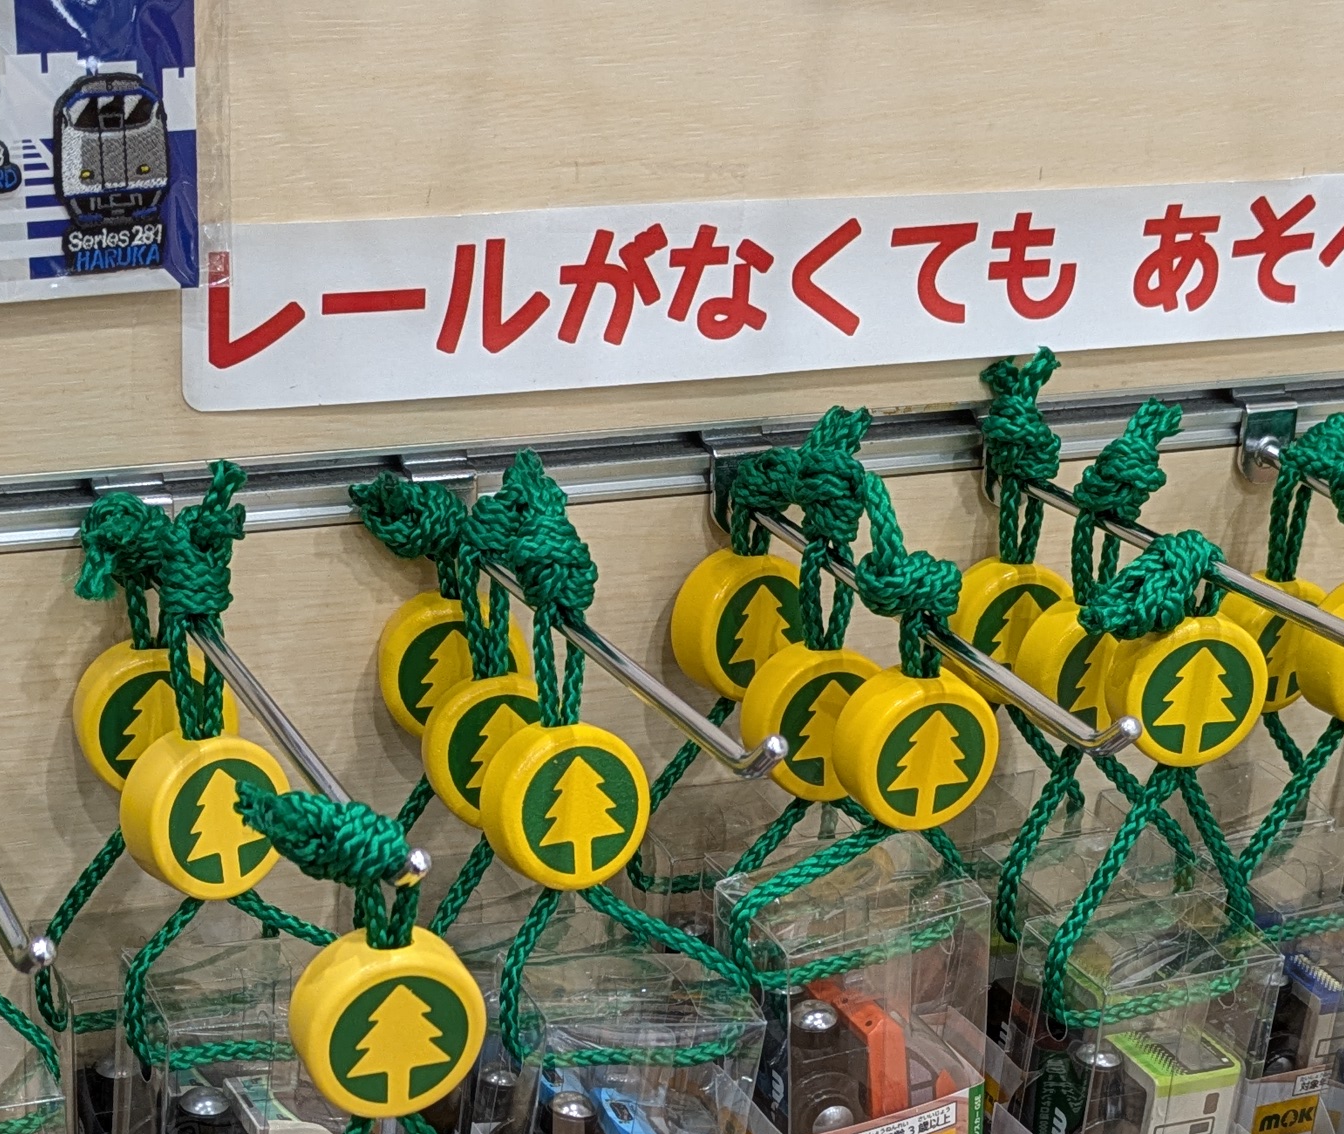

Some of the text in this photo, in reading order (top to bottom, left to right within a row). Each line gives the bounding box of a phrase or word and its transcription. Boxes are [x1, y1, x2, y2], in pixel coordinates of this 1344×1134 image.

[68, 225, 163, 252] Series 281
[76, 244, 160, 271] HARUKA
[206, 215, 1077, 370] レールがなくても
